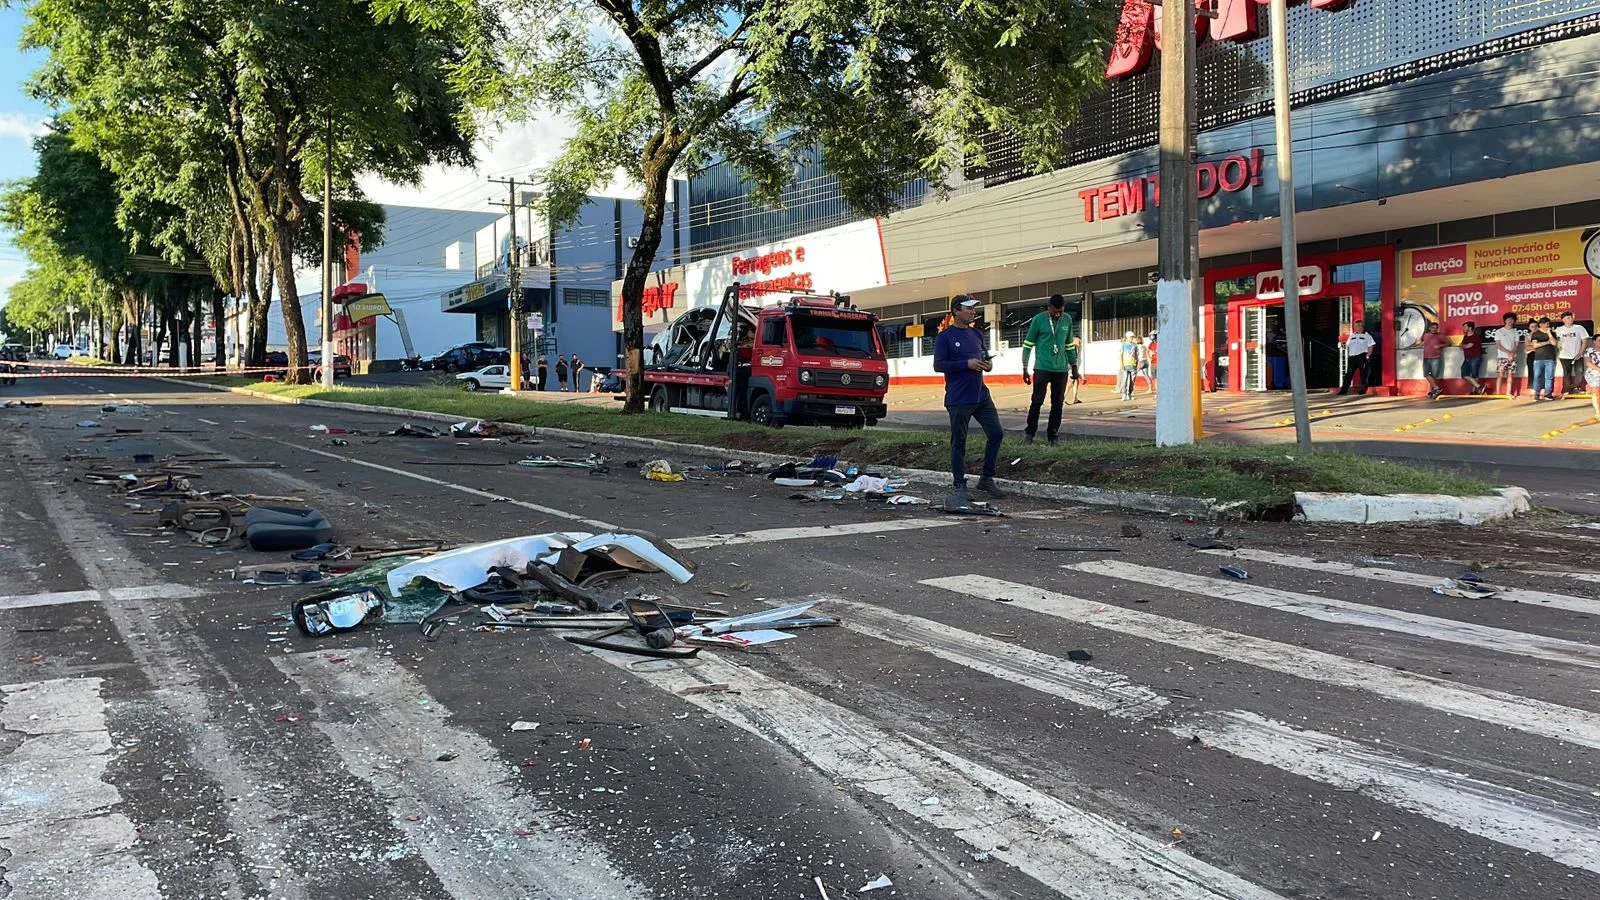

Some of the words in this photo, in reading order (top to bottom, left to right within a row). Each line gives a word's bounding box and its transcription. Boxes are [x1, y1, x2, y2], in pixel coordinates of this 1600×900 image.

[1078, 177, 1146, 223] TEM
[1146, 148, 1264, 208] TDO!
[1474, 249, 1501, 259] Novo
[1503, 241, 1543, 255] Horário
[1545, 240, 1560, 251] de
[732, 248, 792, 277] Ferragens
[795, 245, 806, 263] e
[1415, 258, 1463, 273] atenção
[1474, 252, 1560, 270] Funcionamento
[1506, 270, 1514, 278] DE
[1515, 267, 1553, 277] DEZEMBRO
[737, 271, 812, 301] erramentas
[1259, 273, 1317, 295] Mar
[1505, 282, 1531, 291] Horário
[1532, 280, 1567, 290] Estendido
[1568, 279, 1578, 287] de
[1448, 291, 1482, 303] novo
[1504, 290, 1543, 303] Segunda
[1545, 289, 1551, 298] à
[1552, 288, 1577, 297] Sexta
[1448, 301, 1499, 317] horário
[1512, 302, 1543, 313] 07:45h
[1544, 301, 1555, 311] às
[1556, 300, 1571, 310] 12h
